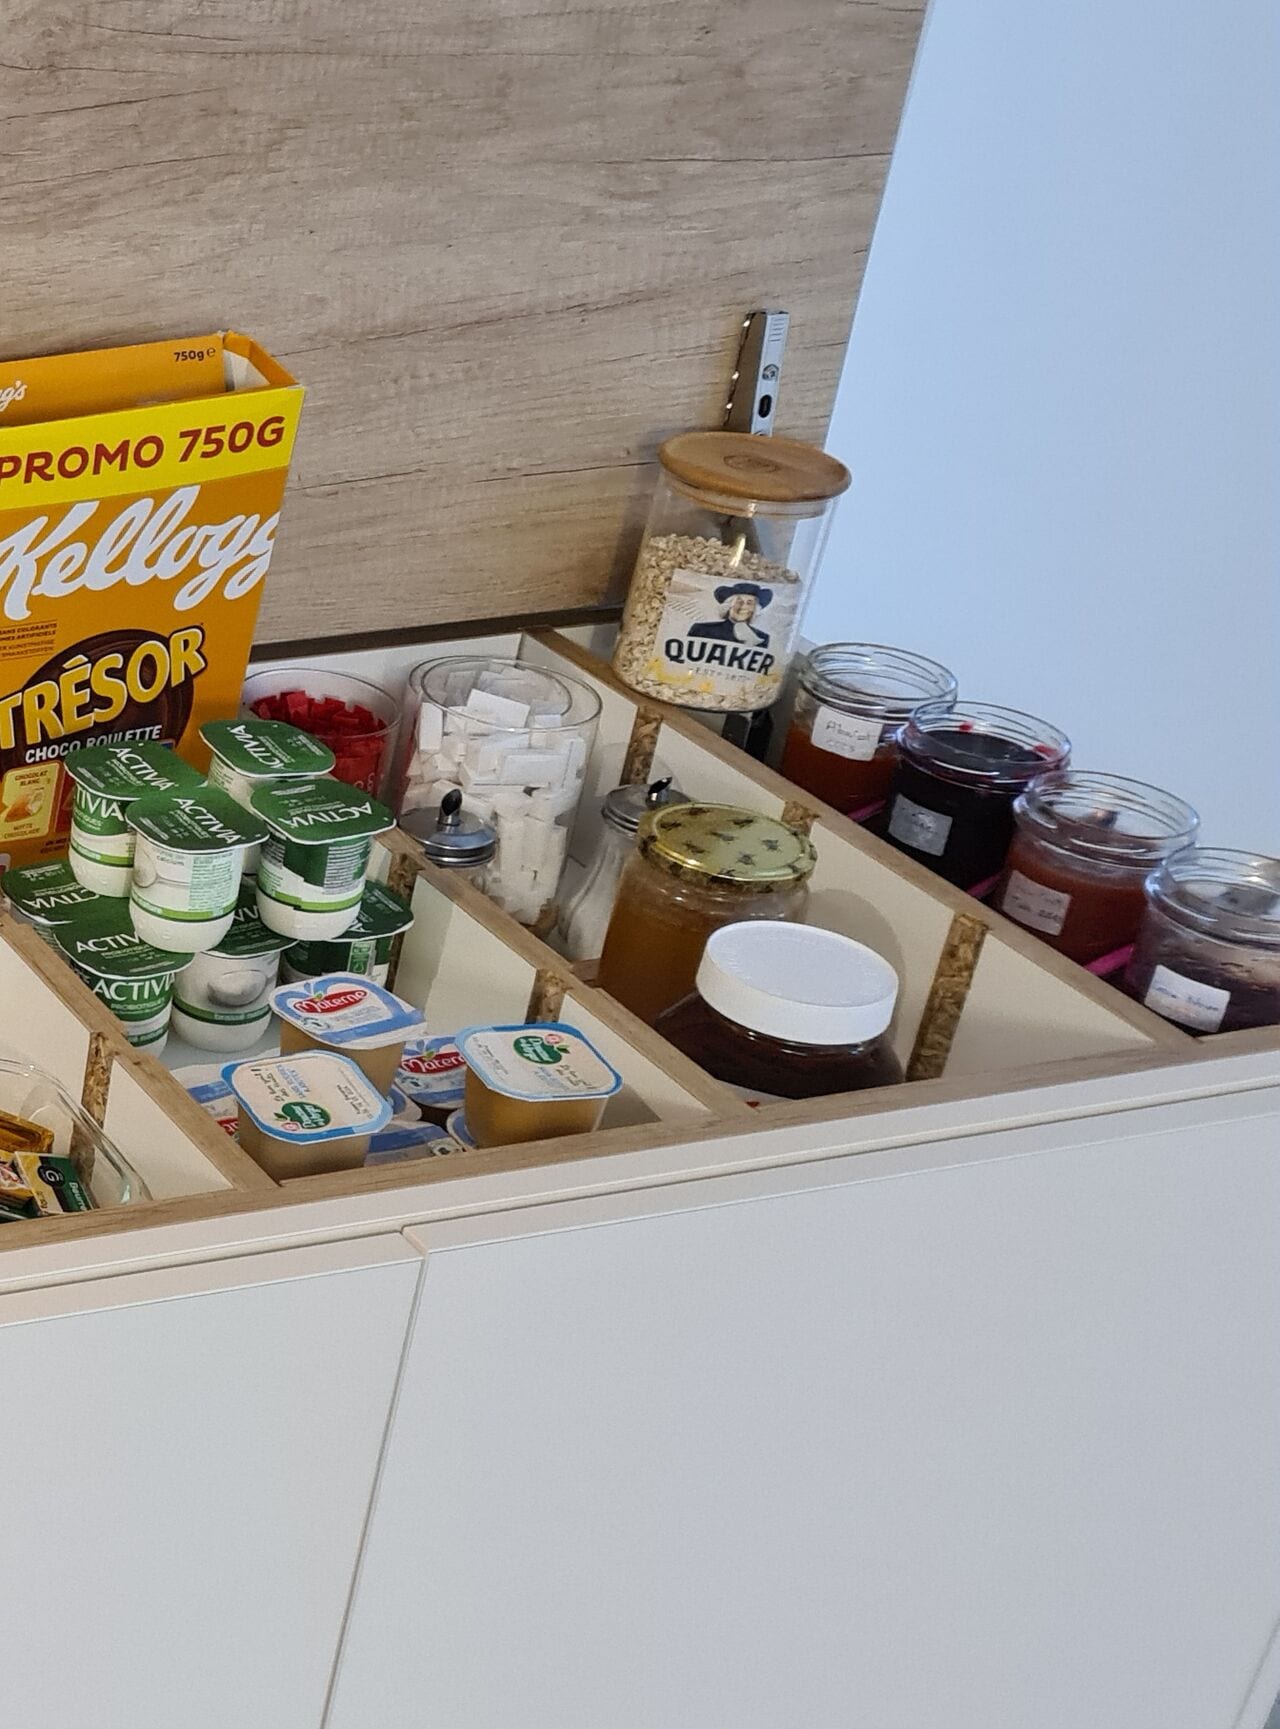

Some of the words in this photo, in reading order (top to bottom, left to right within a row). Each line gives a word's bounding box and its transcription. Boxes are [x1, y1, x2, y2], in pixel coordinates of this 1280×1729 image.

[173, 350, 205, 363] 750g
[178, 415, 286, 464] 750G
[664, 637, 775, 676] QUAKER
[25, 741, 82, 764] CHOCO
[229, 724, 292, 770] ACTIVIA
[108, 748, 176, 791] ACTIVIA
[76, 782, 125, 822] TIVIA
[278, 801, 373, 829] ACTIVIA
[172, 798, 242, 844] ACTIVIA
[22, 888, 100, 909] CTIVIA
[75, 930, 140, 954] ACTIV
[295, 989, 368, 1013] Materne
[401, 1053, 466, 1073] Matern
